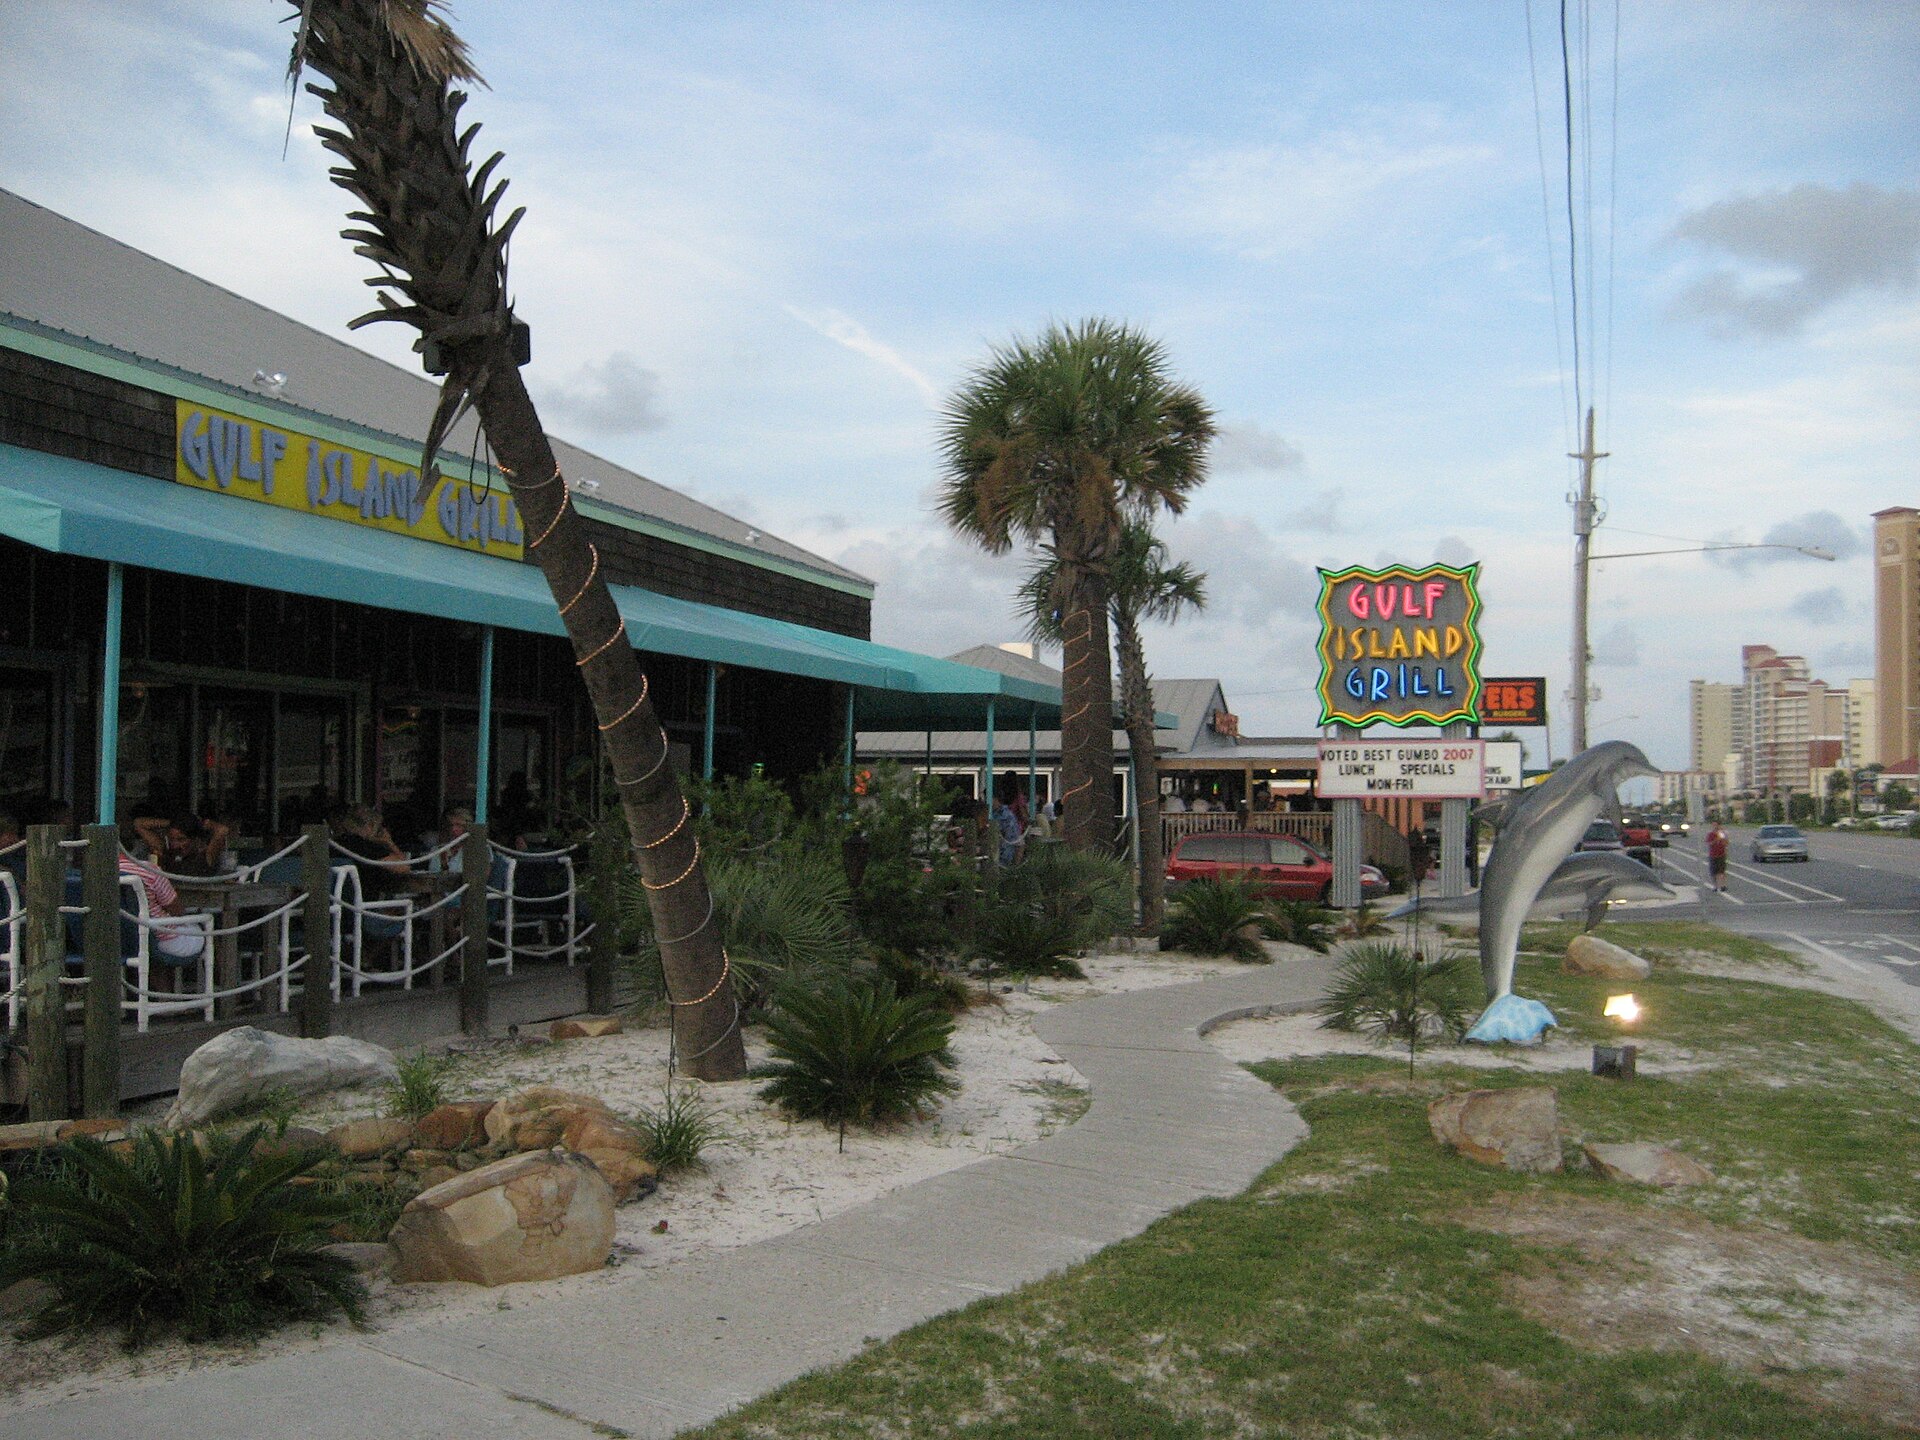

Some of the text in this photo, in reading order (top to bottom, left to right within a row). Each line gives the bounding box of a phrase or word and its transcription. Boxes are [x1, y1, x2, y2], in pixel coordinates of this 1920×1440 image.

[180, 411, 288, 495] GULF
[437, 481, 524, 549] GRILL
[1347, 582, 1447, 621] GULF
[1335, 625, 1464, 662] ISLAND
[1345, 663, 1454, 701] GRILL
[1478, 686, 1536, 710] ERS
[1320, 748, 1474, 761] VOTED BEST GUMBO 2007
[1338, 763, 1455, 776] LUNCH SPECIALS
[1367, 778, 1414, 790] MON-FRI
